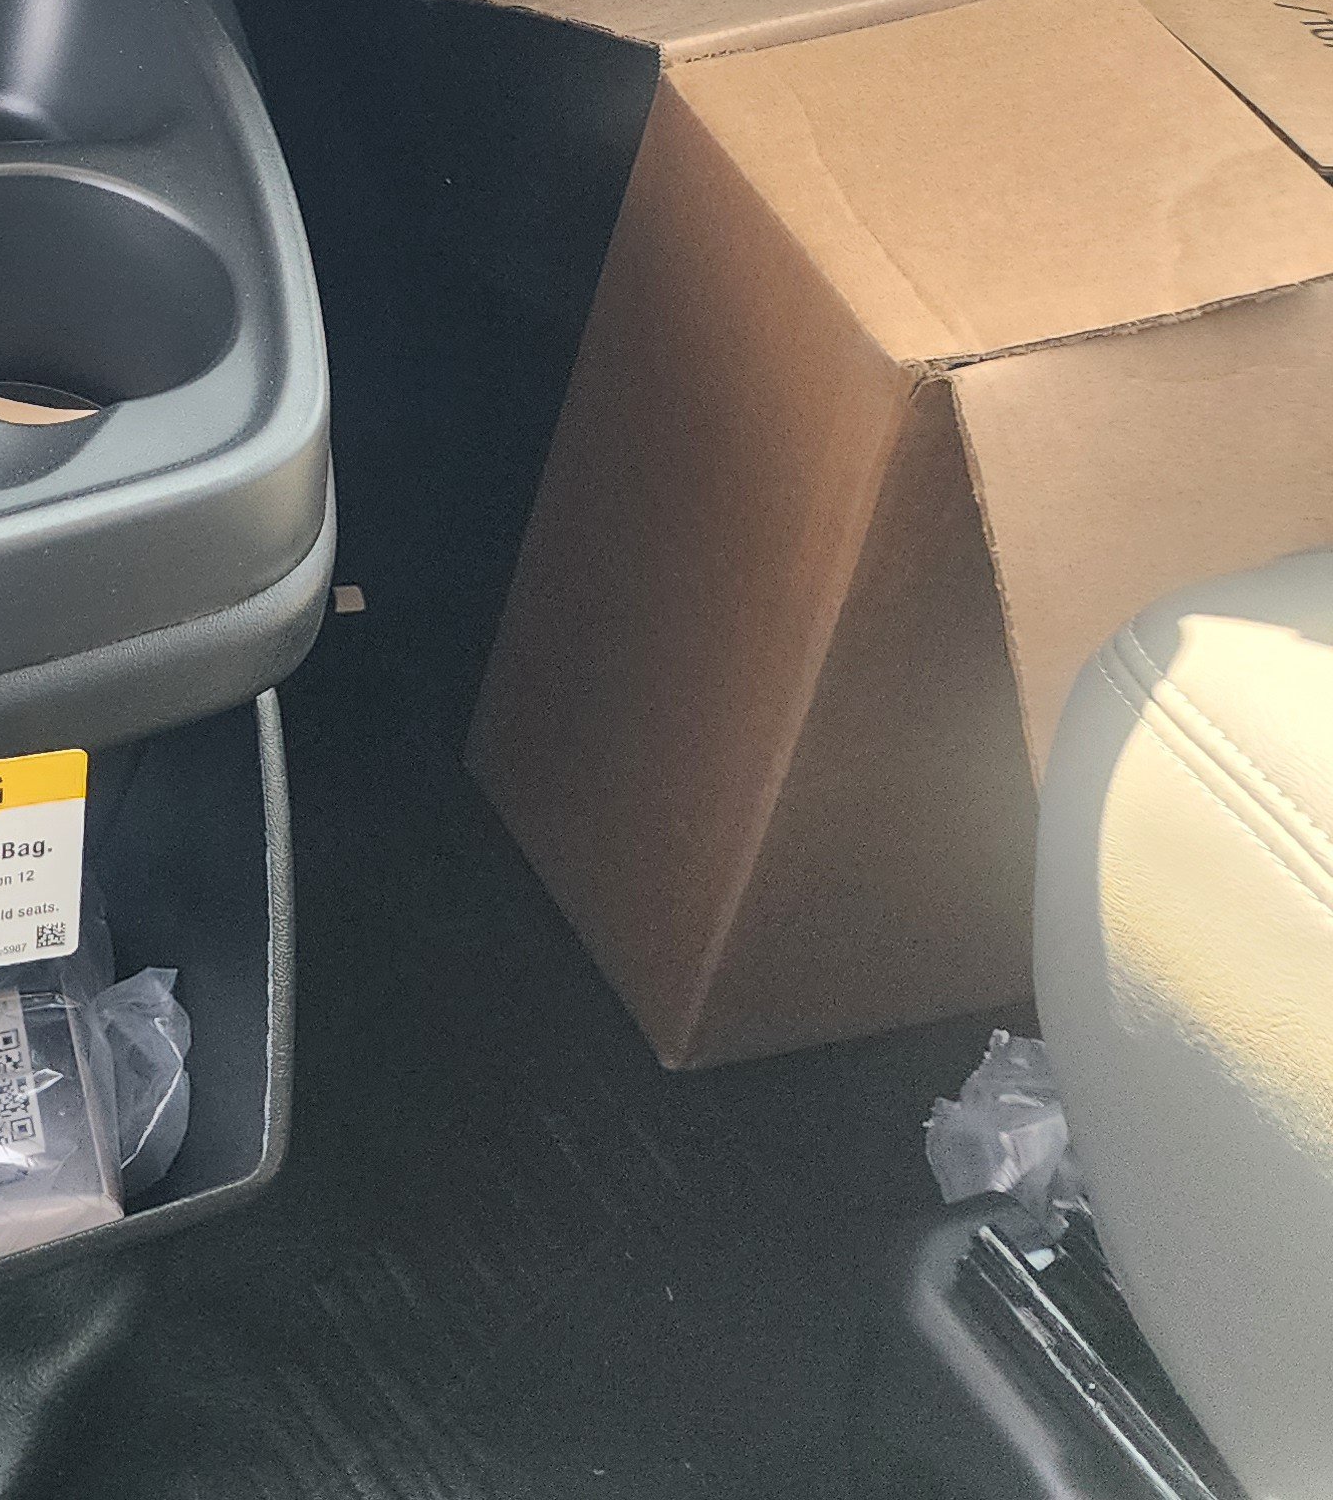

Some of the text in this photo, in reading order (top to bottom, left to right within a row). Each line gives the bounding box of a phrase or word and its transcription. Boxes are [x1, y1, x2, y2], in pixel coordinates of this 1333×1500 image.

[1, 837, 54, 860] Bag.
[18, 869, 35, 883] 12
[17, 902, 60, 918] seats.
